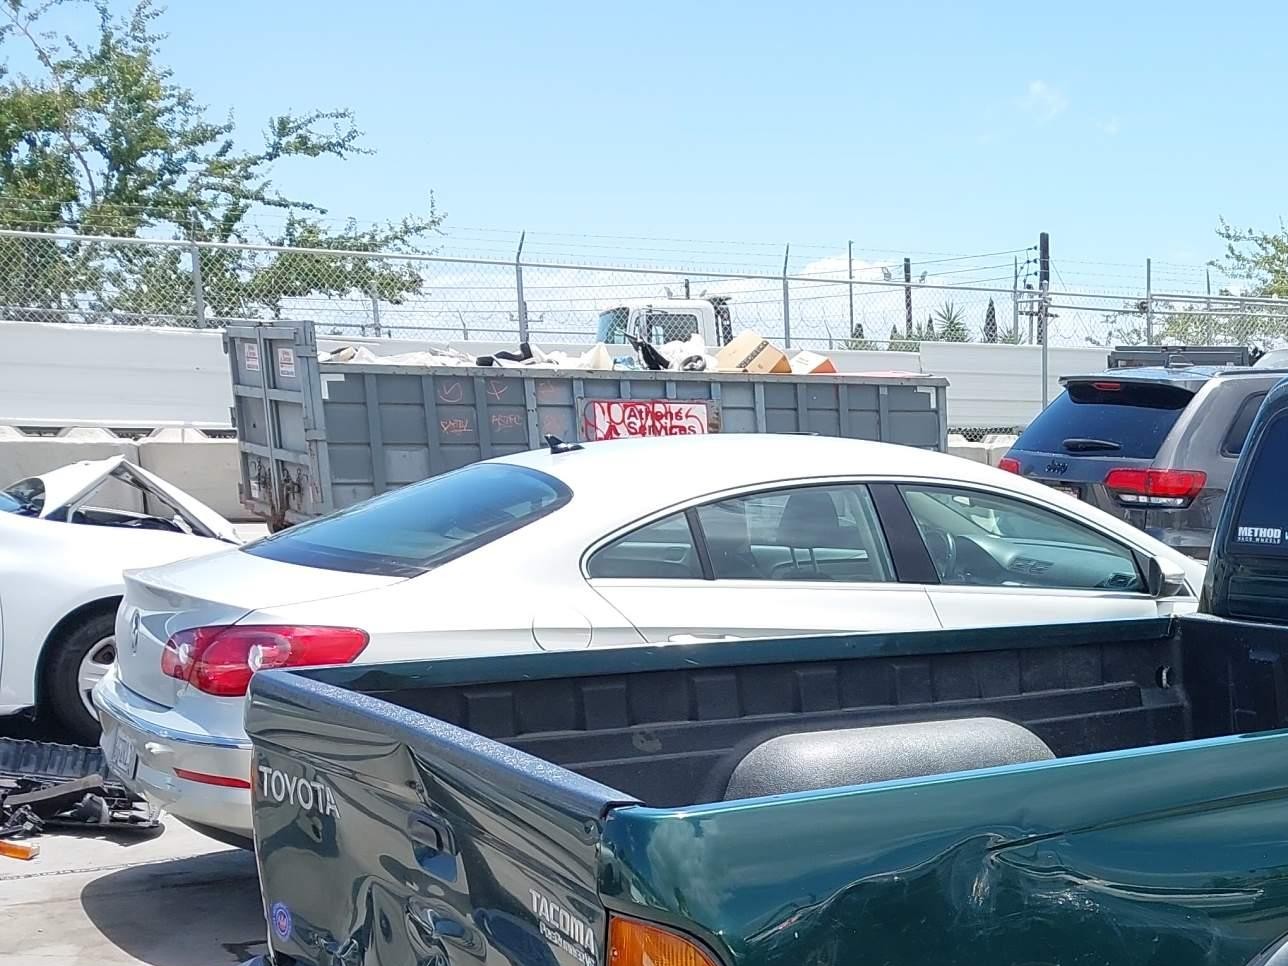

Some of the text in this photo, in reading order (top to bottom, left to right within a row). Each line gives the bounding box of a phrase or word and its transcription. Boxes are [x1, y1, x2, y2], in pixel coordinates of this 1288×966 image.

[1238, 526, 1282, 538] METHOD
[258, 765, 341, 819] TOYOTA
[529, 888, 595, 955] TACOMA
